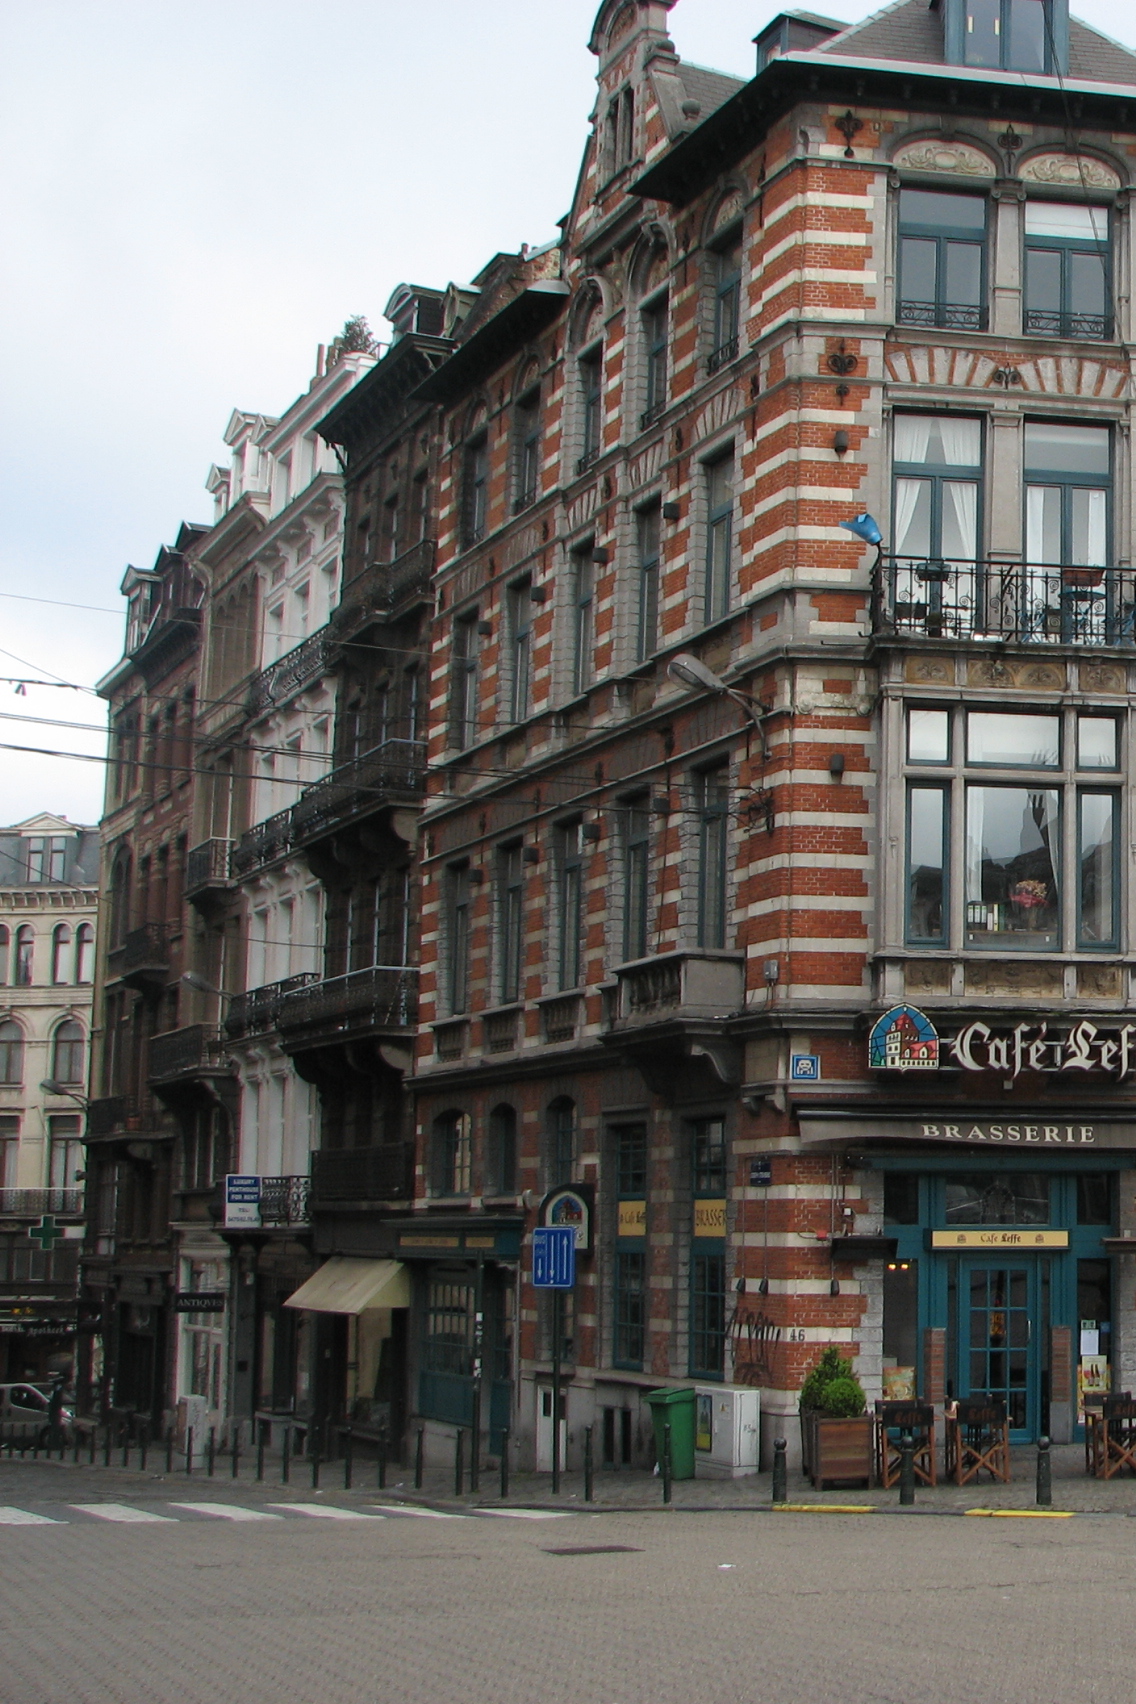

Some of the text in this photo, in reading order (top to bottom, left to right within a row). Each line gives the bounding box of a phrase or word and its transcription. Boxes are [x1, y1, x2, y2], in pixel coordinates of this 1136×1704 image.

[950, 1021, 1048, 1081] Café
[921, 1125, 1095, 1143] BRASSERIE
[1000, 1233, 1022, 1244] Leffe
[789, 1328, 806, 1342] 46
